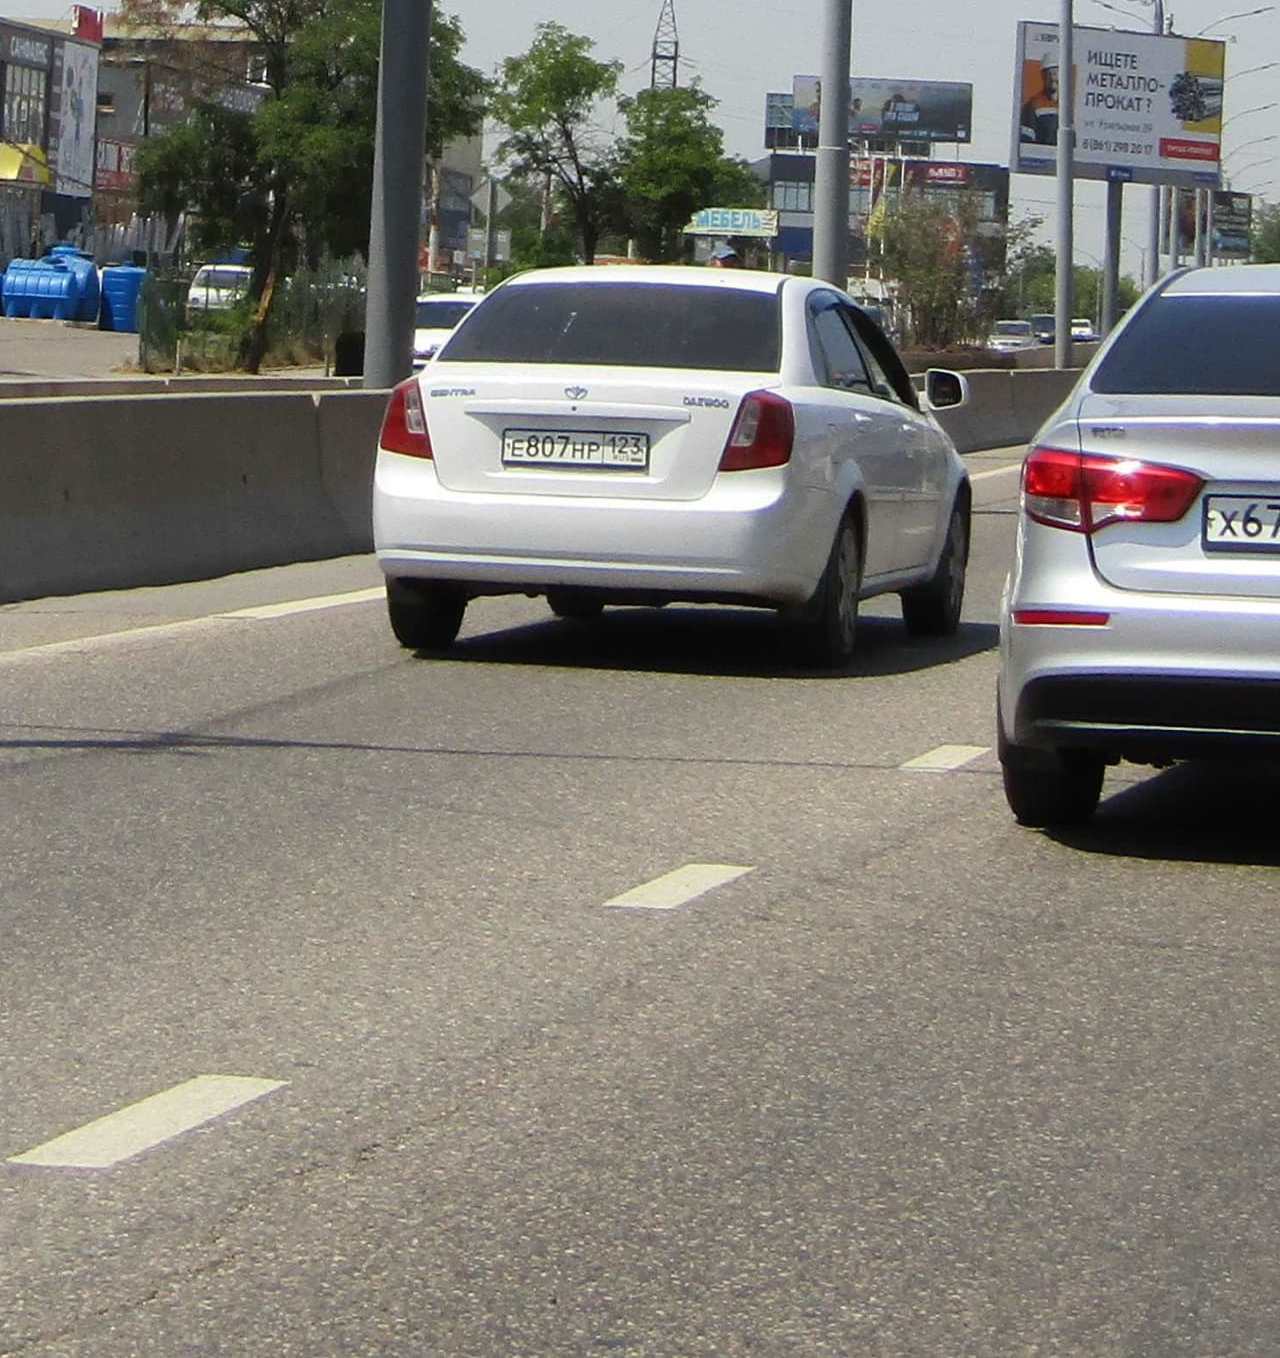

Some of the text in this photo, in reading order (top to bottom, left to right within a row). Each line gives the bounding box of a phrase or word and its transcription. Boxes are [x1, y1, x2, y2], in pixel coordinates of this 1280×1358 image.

[1087, 50, 1138, 70] ИЩЕТЕ
[1086, 73, 1165, 92] МЕТАЛЛО-
[697, 210, 761, 229] МЕБЕЛЬ
[683, 396, 730, 409] DAEWOO
